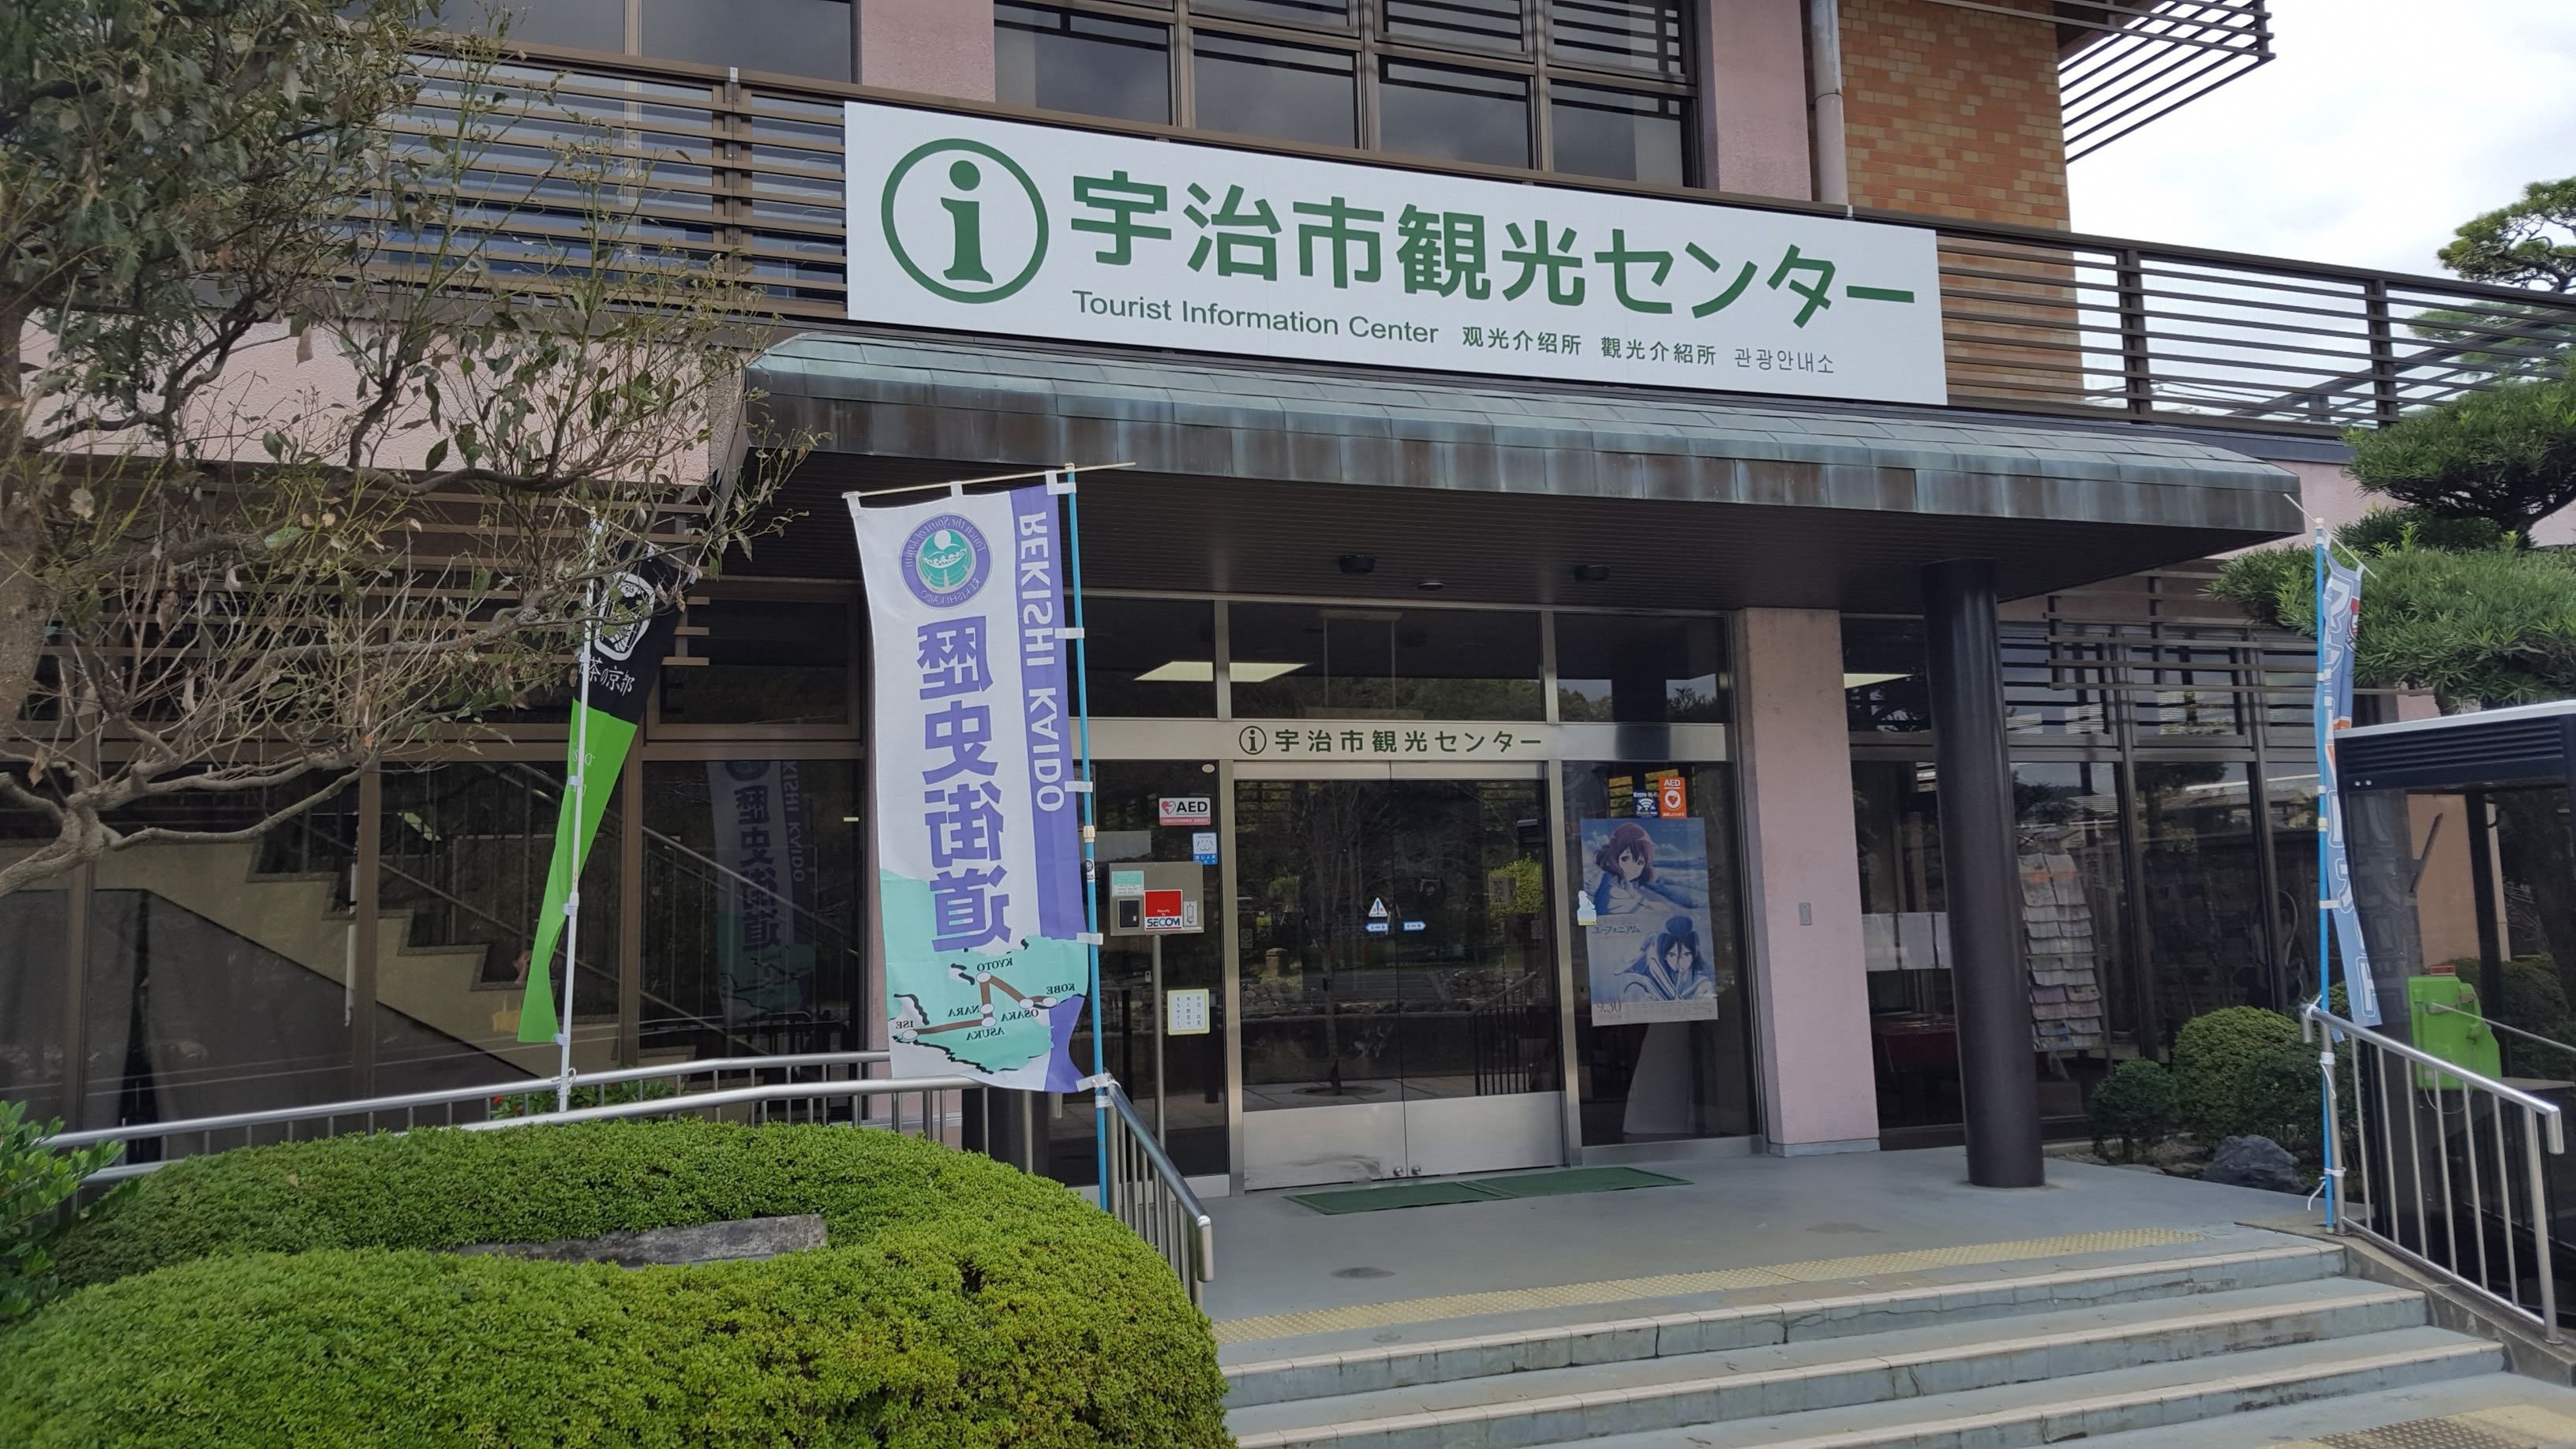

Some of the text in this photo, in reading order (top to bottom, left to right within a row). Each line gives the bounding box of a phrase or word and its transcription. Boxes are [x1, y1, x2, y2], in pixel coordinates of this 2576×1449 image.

[1071, 170, 1915, 328] 宇治市観光センター
[1072, 290, 1440, 344] Tourist Information Center
[1462, 324, 1582, 356] 观光介绍所
[1601, 335, 1717, 367] 觀光介紹所
[1734, 347, 1835, 374] 관광안내소
[579, 657, 636, 697] 茶の京都
[1274, 729, 1541, 754] 宇治市観光センター
[1176, 801, 1208, 813] AED
[1147, 917, 1181, 927] SECOM
[1597, 998, 1622, 1013] 9.30
